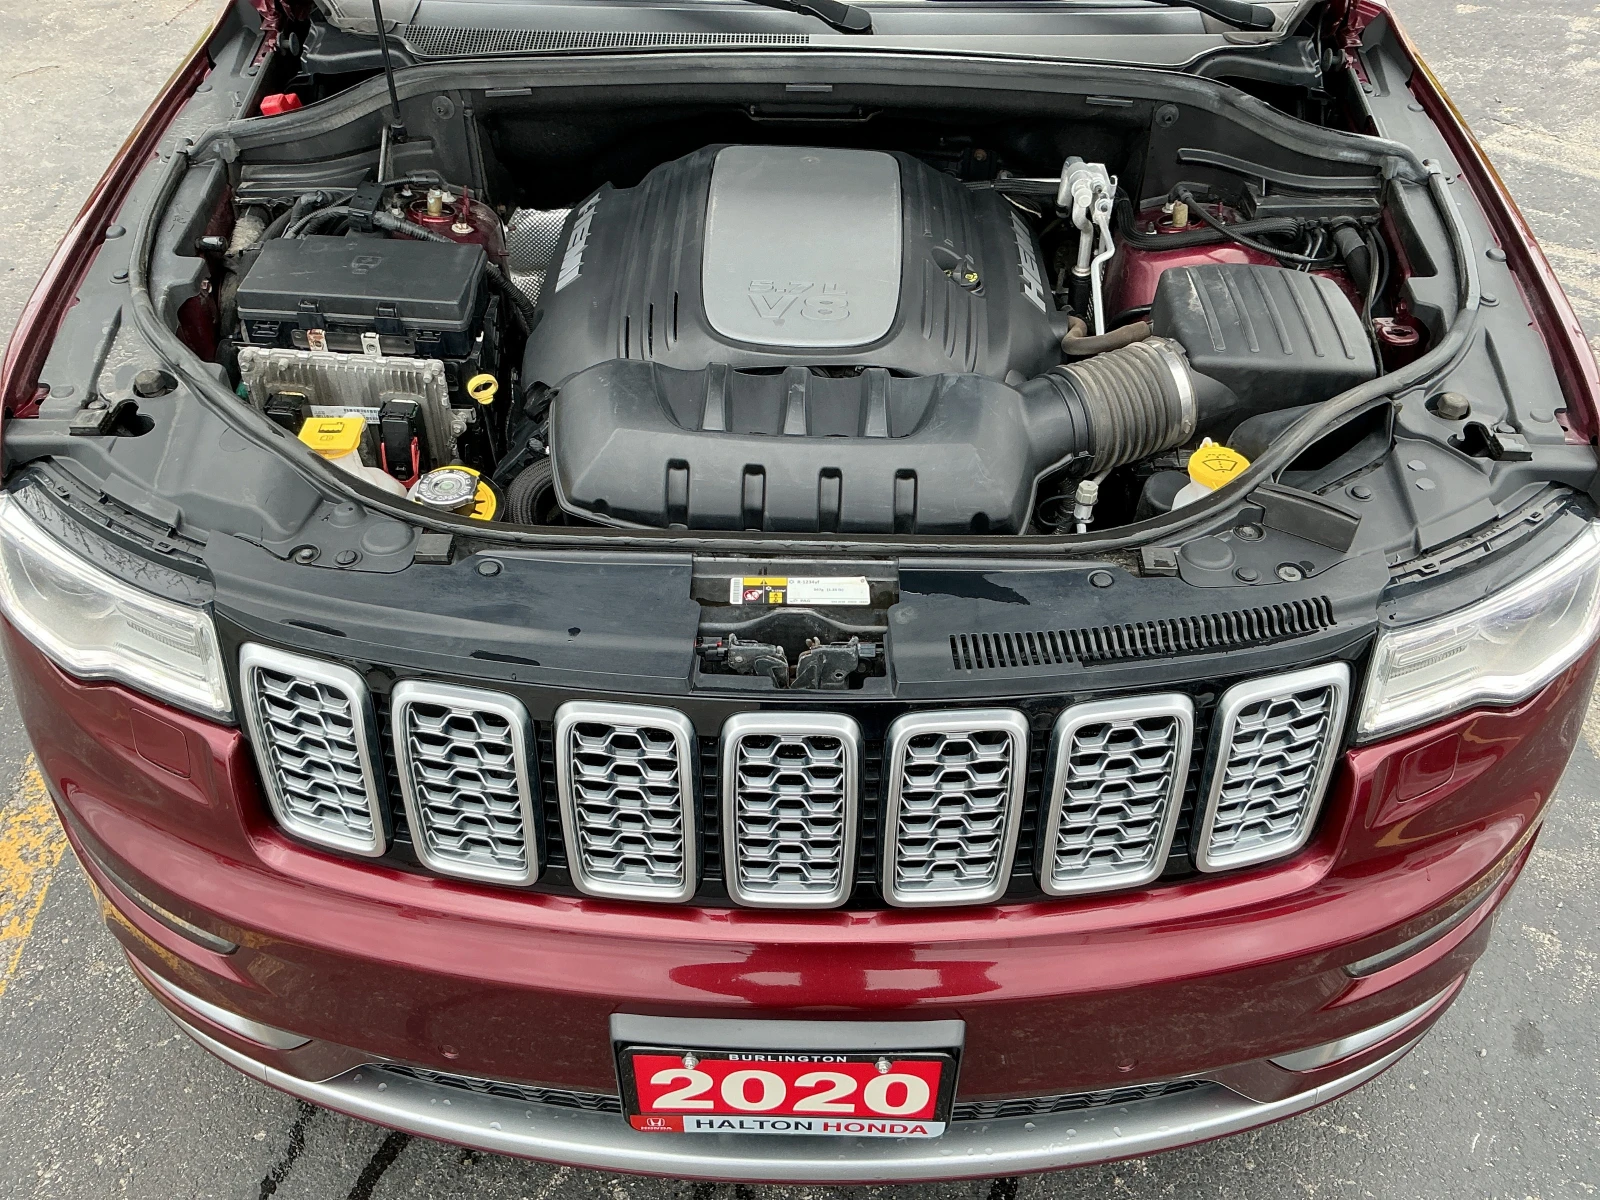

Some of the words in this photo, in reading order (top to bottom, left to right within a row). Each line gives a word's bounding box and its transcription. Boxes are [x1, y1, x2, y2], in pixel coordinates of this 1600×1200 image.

[555, 192, 602, 294] HEMI
[1008, 210, 1047, 314] HEMI
[748, 280, 815, 293] 5.7
[747, 293, 850, 321] V8
[728, 1053, 848, 1063] BURLINGTON
[650, 1068, 931, 1115] 2020
[695, 1118, 813, 1132] HALTON
[822, 1121, 929, 1135] HONDA
